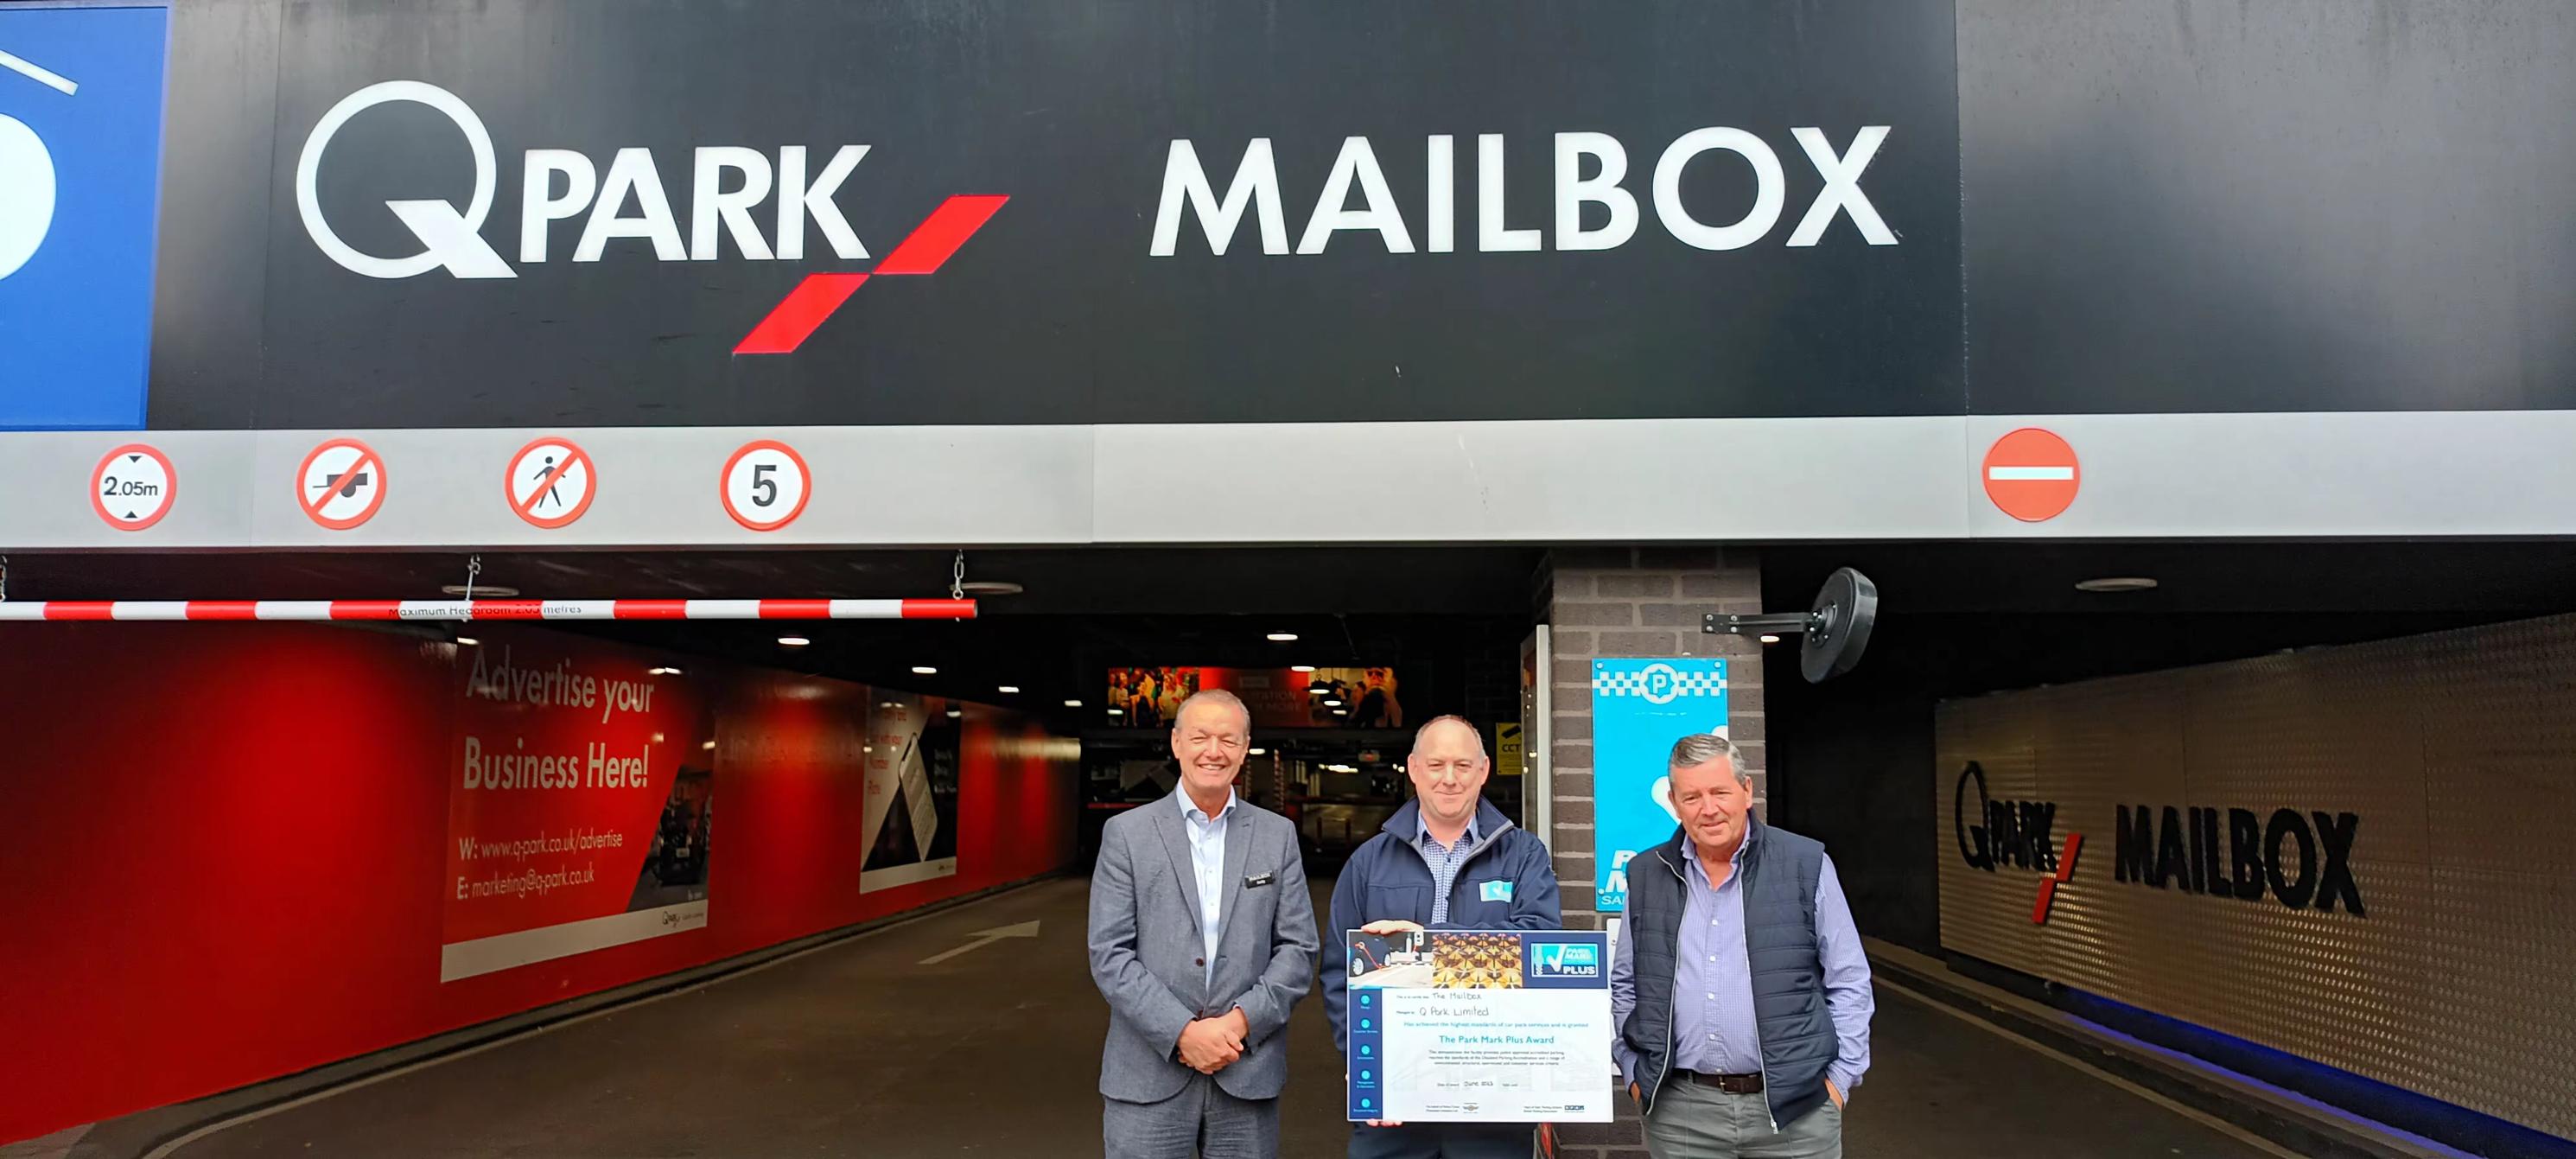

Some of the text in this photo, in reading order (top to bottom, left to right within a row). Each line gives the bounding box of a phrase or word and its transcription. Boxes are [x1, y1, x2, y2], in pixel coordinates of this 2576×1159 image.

[1149, 126, 1899, 257] MAILBOX
[104, 476, 158, 496] 2.05m
[752, 464, 777, 506] 5
[389, 607, 445, 616] Maximum
[449, 605, 511, 616] Headroom
[544, 606, 582, 615] metres
[465, 644, 654, 723] Advertise your
[463, 736, 649, 790] Business Here!
[459, 827, 623, 863] W: www.q-park.co.uk/advertise
[2115, 804, 2367, 919] MAILBOX
[457, 862, 595, 900] E: marketing@q-park.co.uk
[1562, 965, 1596, 976] PLUS
[1419, 1007, 1427, 1016] Q
[1453, 1005, 1490, 1017] Limited
[1439, 1035, 1555, 1044] The Park Mark Plus Award
